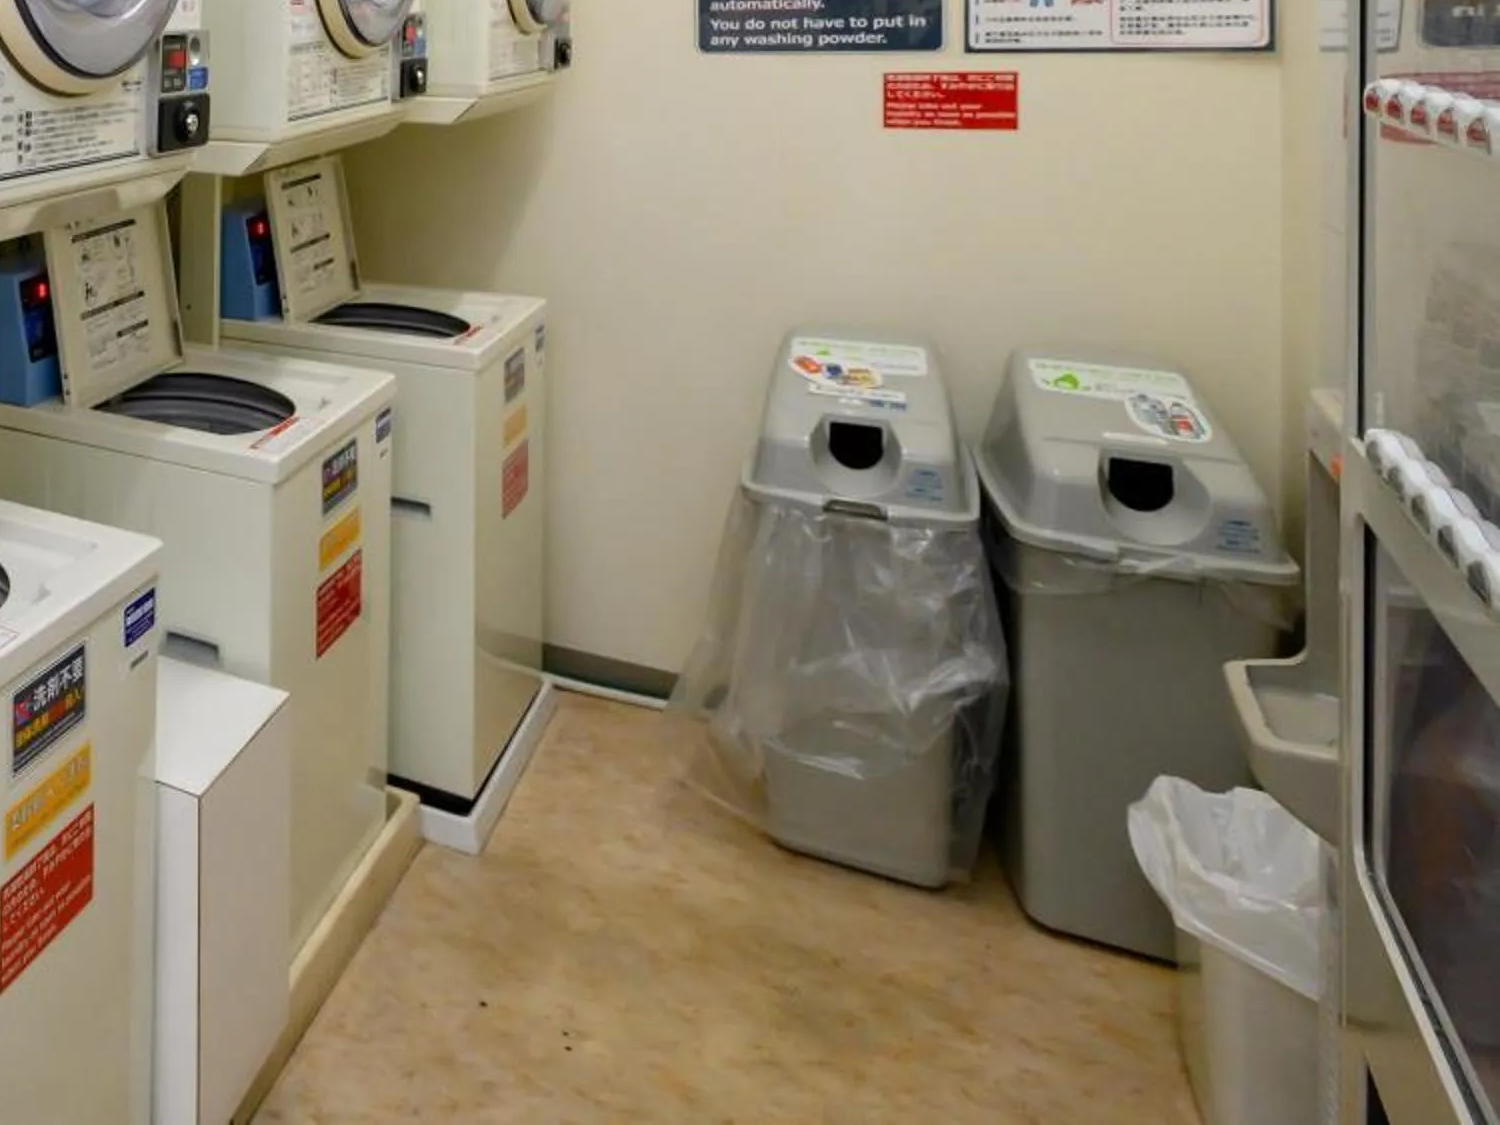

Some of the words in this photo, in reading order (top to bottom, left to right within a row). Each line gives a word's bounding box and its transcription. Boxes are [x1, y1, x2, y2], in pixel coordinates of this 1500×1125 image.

[710, 17, 740, 31] You
[745, 17, 766, 30] do
[770, 18, 798, 30] not
[803, 16, 844, 29] have
[849, 16, 868, 28] to
[873, 16, 904, 31] put
[908, 14, 927, 27] in
[710, 34, 739, 47] any
[743, 32, 814, 47] washing
[818, 32, 888, 46] powder.
